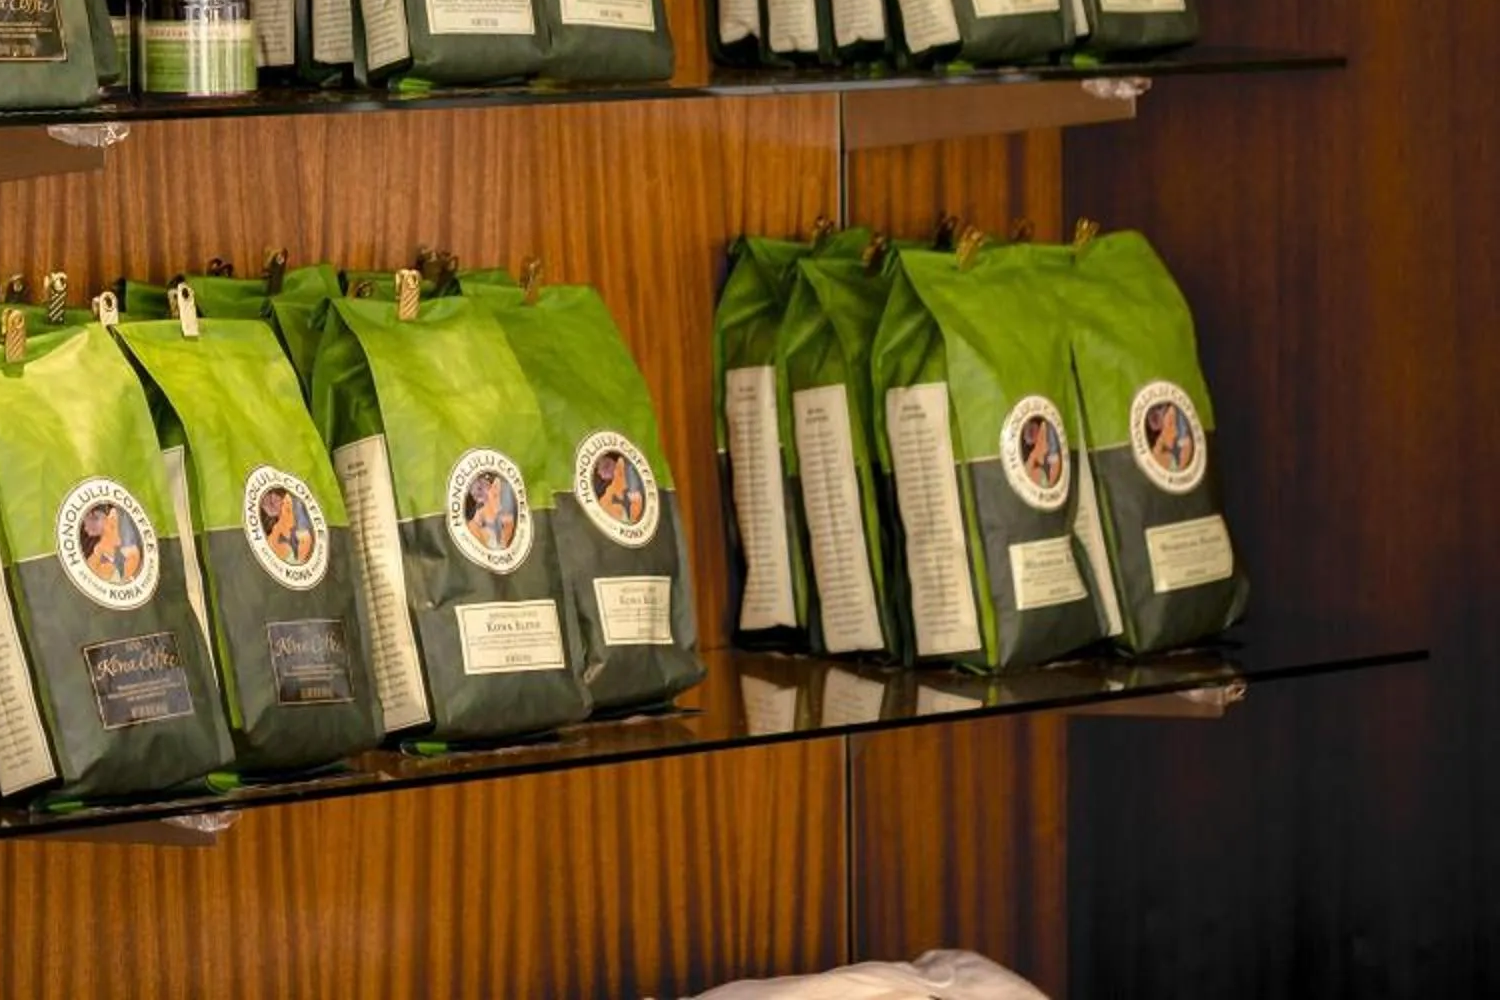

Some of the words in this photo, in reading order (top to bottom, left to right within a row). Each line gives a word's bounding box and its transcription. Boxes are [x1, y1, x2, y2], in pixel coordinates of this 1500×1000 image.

[284, 477, 325, 537] COFFEE
[449, 453, 496, 527] HONOLULU
[61, 484, 110, 567] HONOLULU
[113, 487, 155, 552] COFFEE
[108, 586, 143, 600] KONA
[284, 567, 313, 581] KONA
[96, 658, 137, 681] Kona
